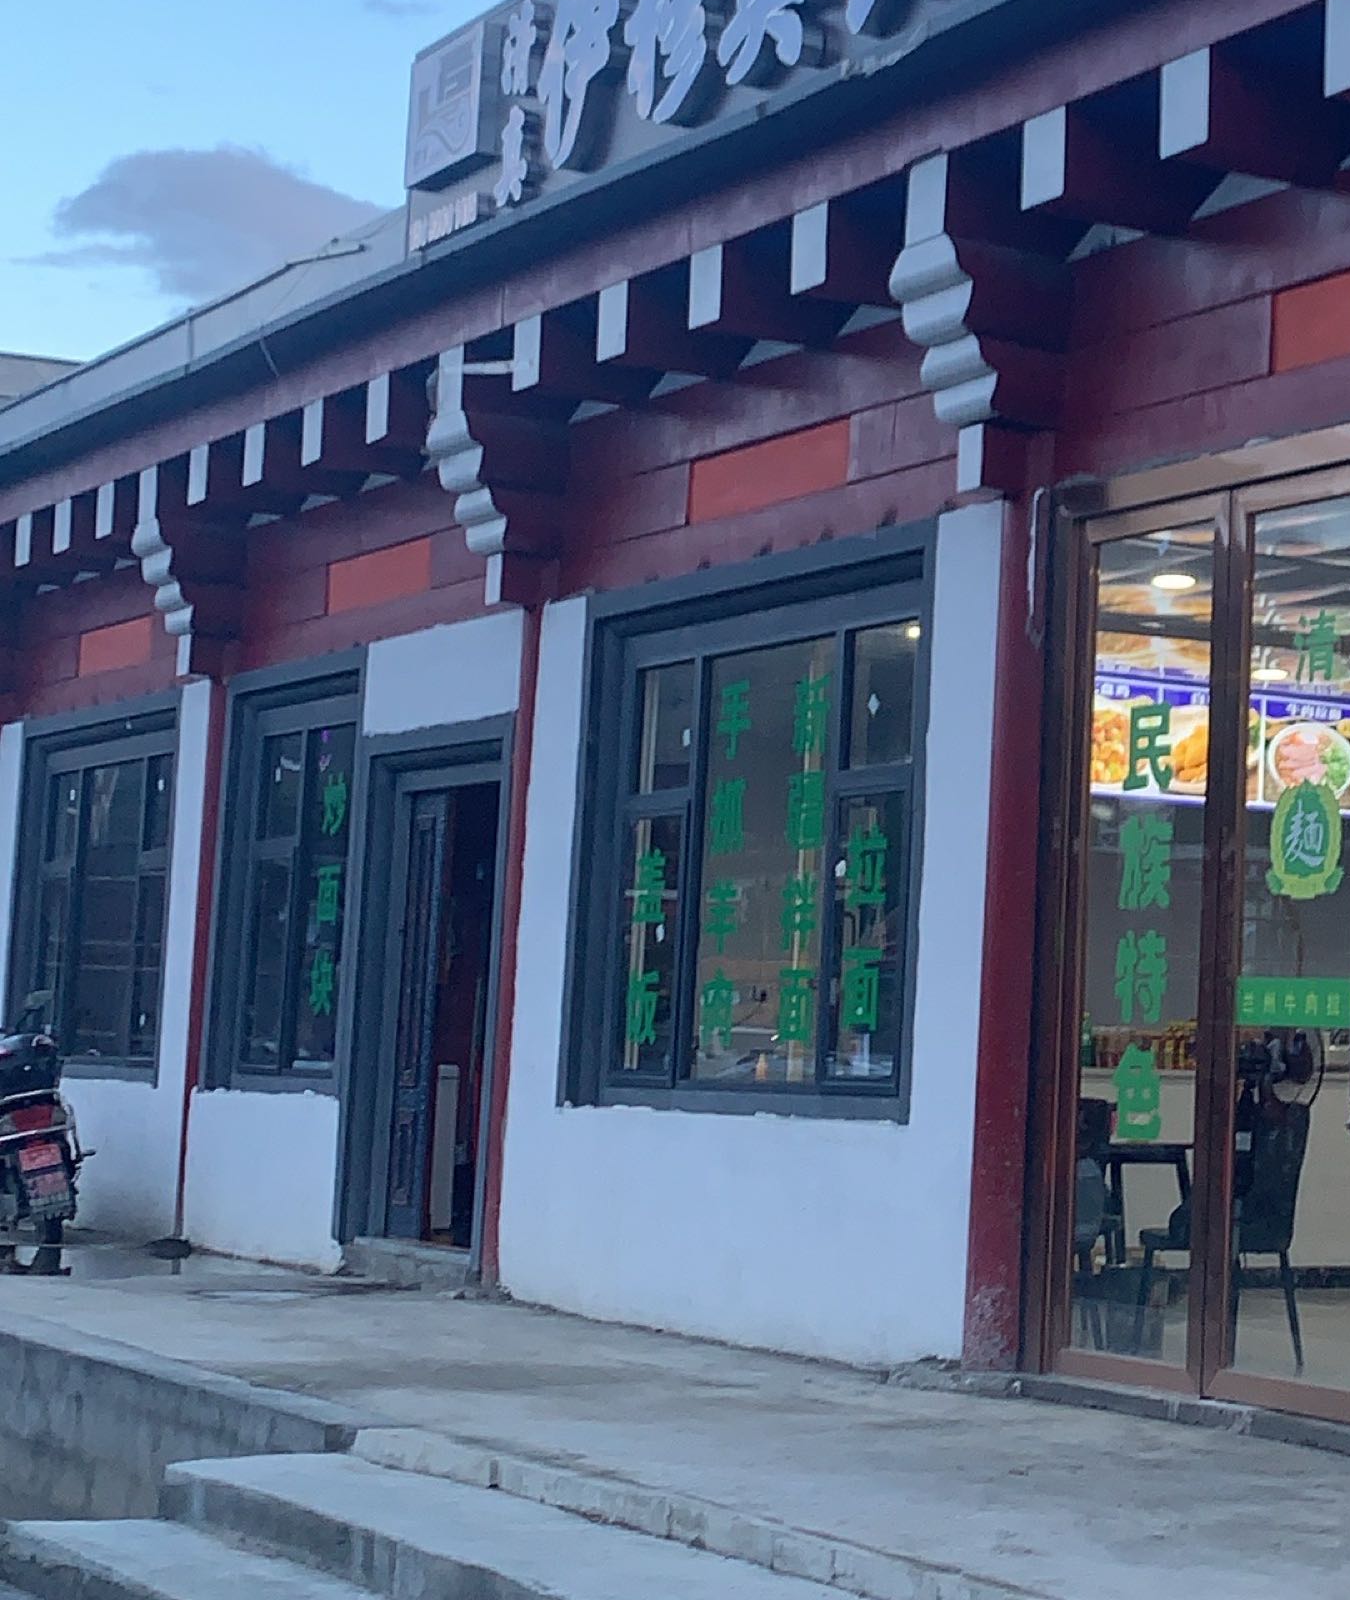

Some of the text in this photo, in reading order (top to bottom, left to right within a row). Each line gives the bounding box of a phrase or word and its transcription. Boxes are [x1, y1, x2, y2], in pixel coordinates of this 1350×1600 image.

[1295, 610, 1342, 681] 清
[1112, 703, 1173, 1141] 民族特色
[1242, 991, 1341, 1016] 兰州牛肉拉
